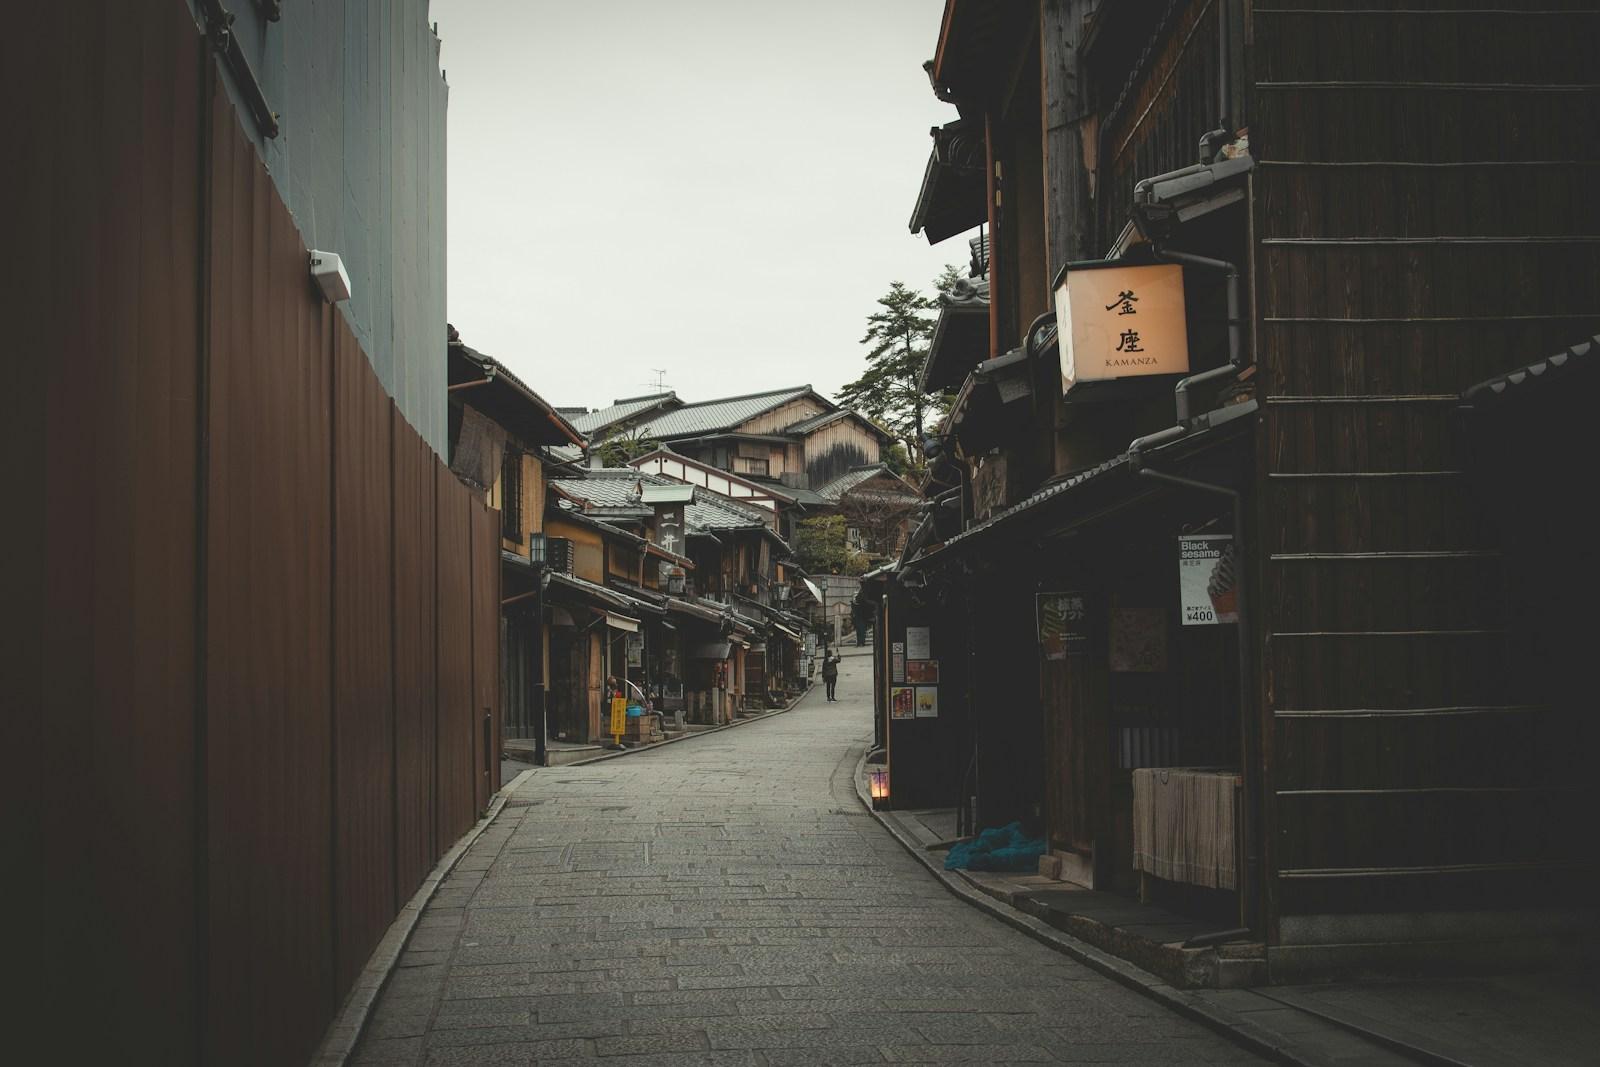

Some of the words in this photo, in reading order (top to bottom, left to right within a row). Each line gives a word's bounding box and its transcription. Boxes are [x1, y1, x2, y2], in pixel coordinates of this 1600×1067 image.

[1105, 290, 1144, 352] 釜座
[1105, 357, 1158, 367] KAMANZA
[1181, 541, 1209, 550] Black
[1181, 549, 1220, 558] sesame
[1057, 611, 1085, 621] ソフト
[1187, 611, 1213, 621] ¥400
